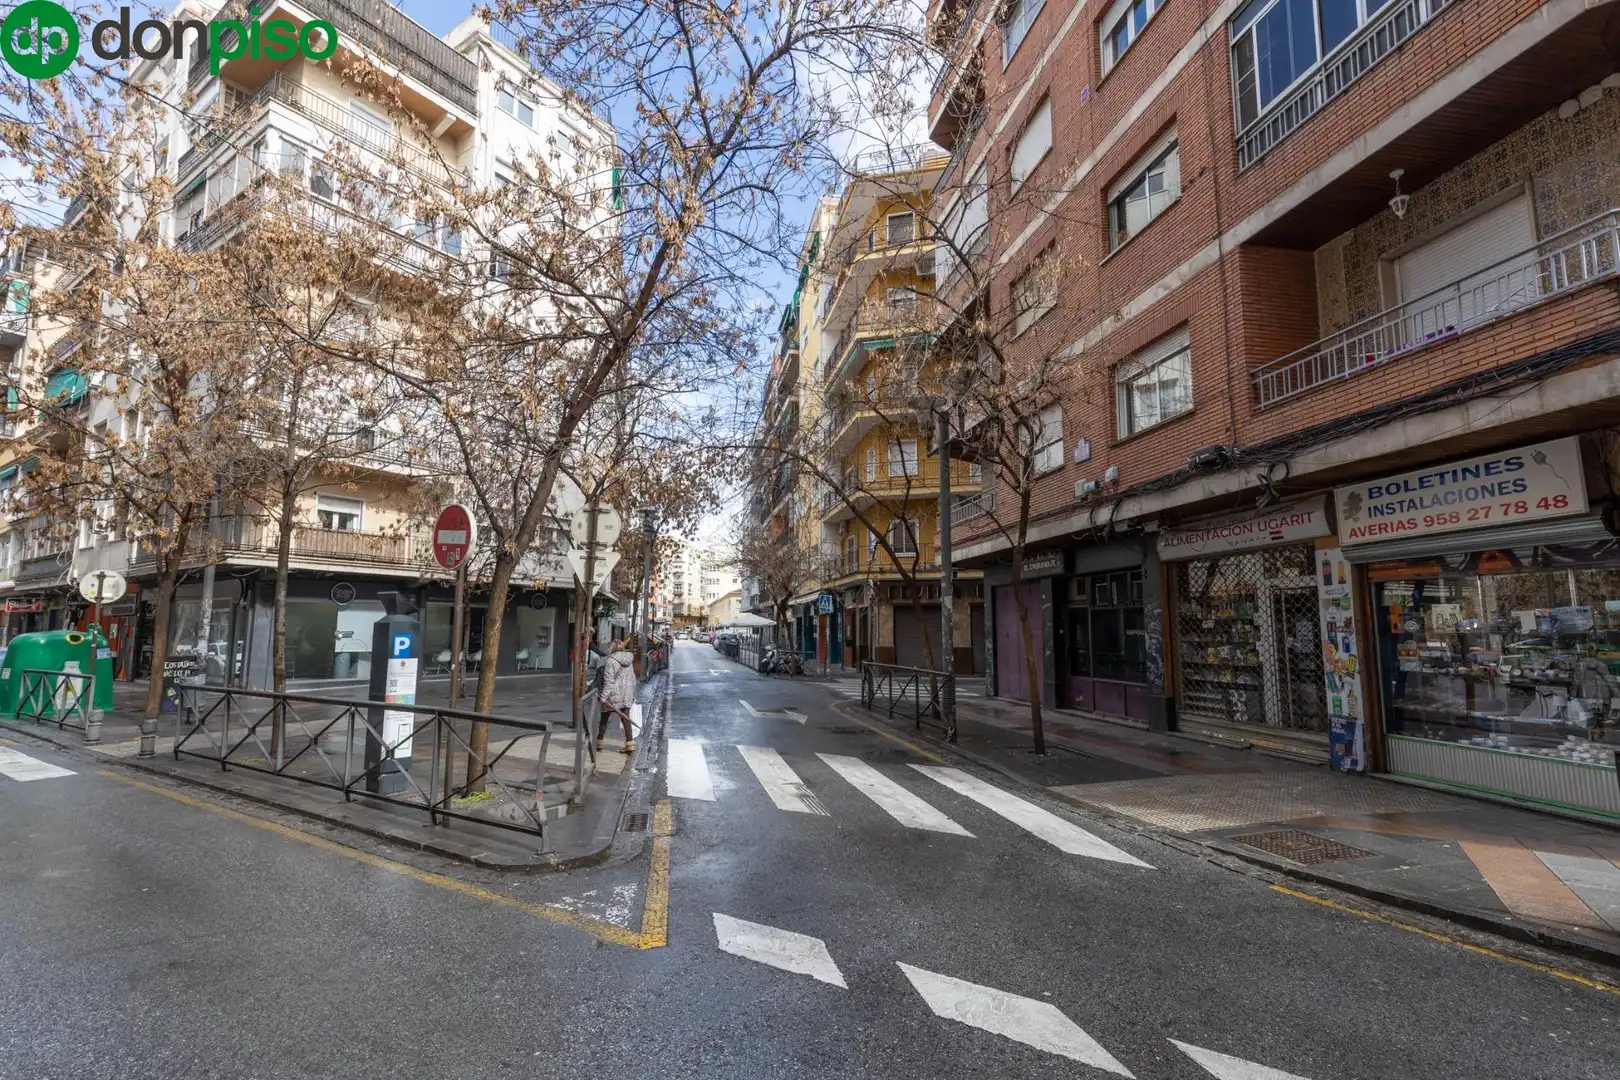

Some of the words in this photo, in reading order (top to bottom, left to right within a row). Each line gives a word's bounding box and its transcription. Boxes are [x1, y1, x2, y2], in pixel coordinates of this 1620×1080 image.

[1367, 456, 1525, 500] BOLETINES
[1367, 478, 1528, 519] INSTALACIONES
[1163, 523, 1254, 548] ALIMENTACION
[1257, 511, 1315, 532] UGARIT
[1349, 518, 1418, 539] AVERIAS
[1423, 511, 1461, 528] 958
[1466, 505, 1493, 522] 27
[1500, 501, 1529, 517] 78
[1536, 494, 1569, 510] 48
[393, 636, 411, 656] P
